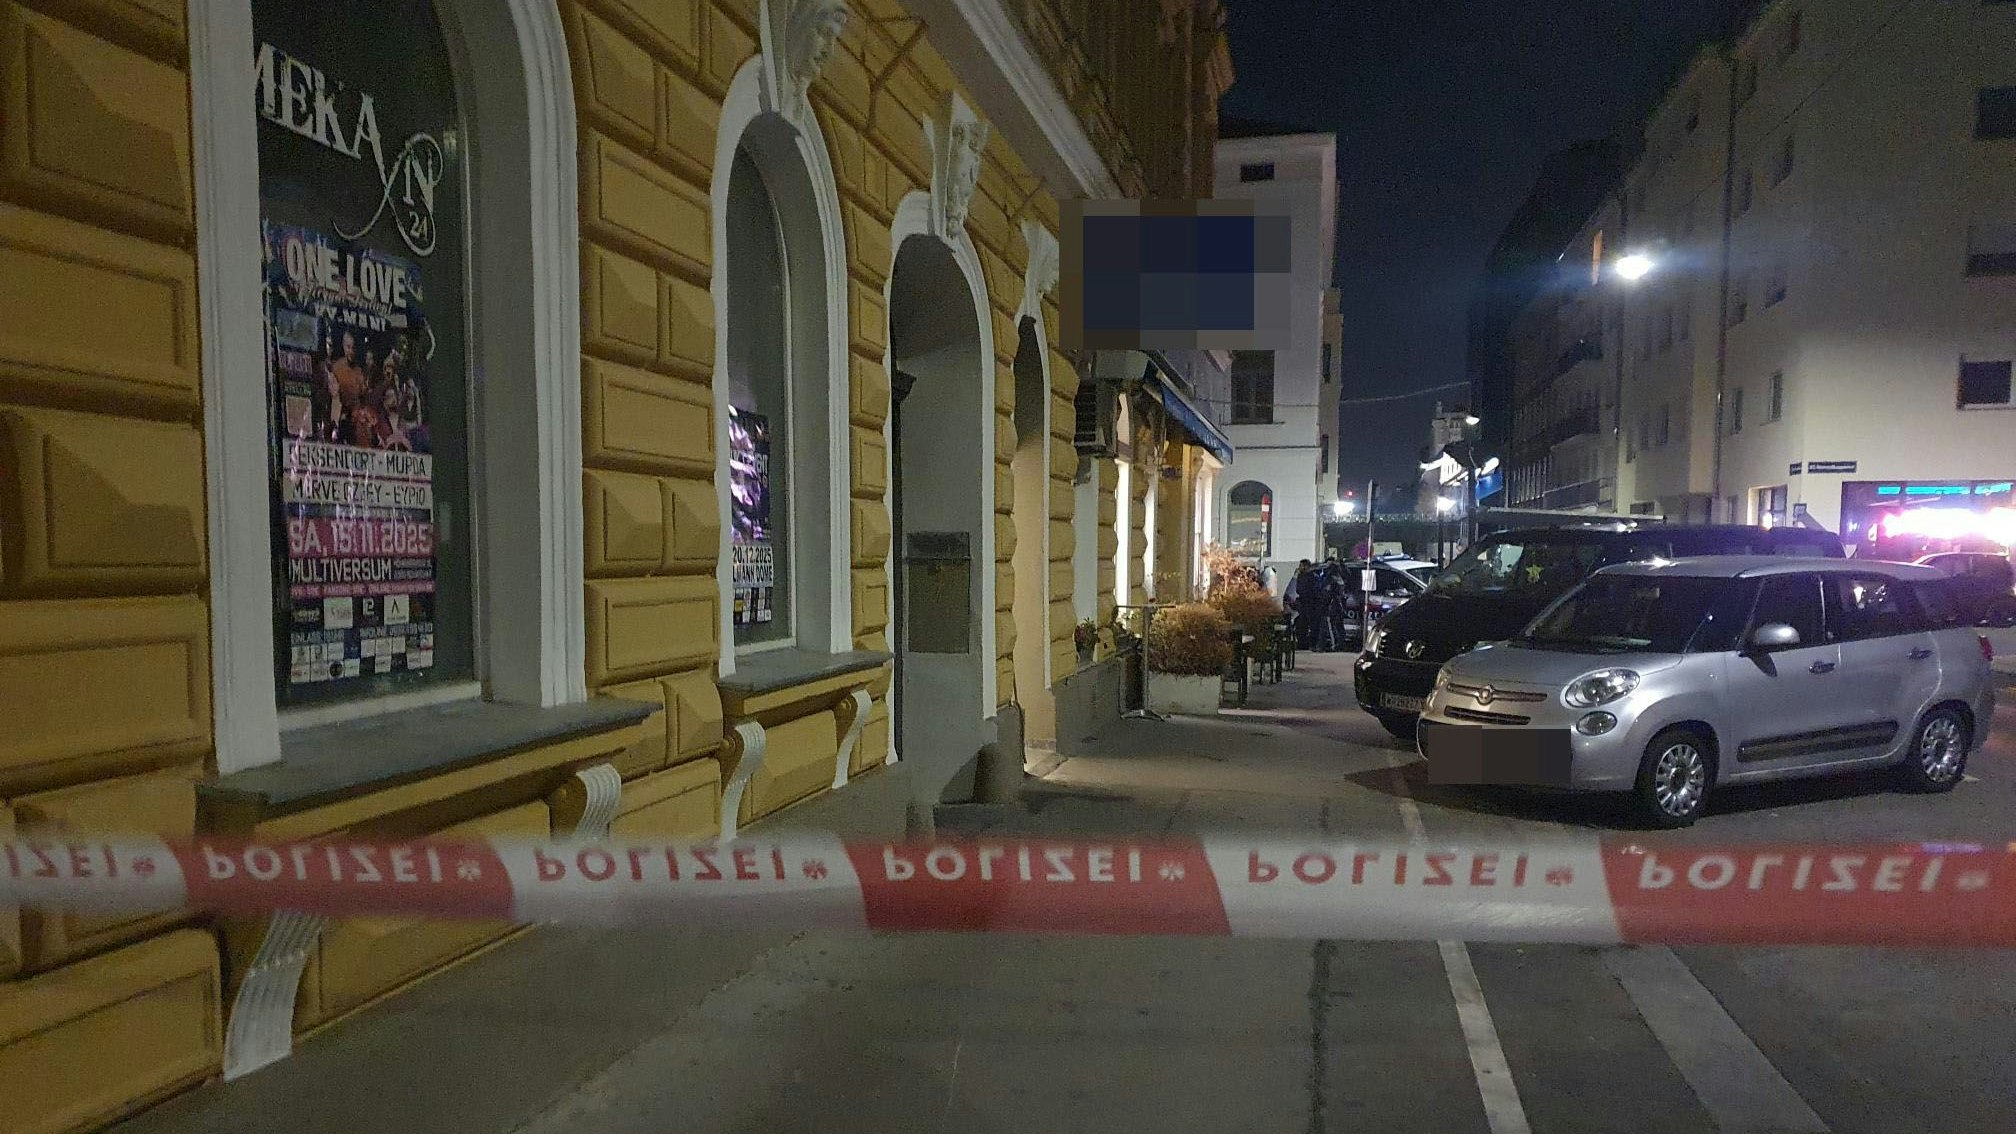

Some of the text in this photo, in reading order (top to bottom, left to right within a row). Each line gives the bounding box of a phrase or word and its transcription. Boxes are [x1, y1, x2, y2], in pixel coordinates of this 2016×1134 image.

[286, 238, 340, 290] ONE
[346, 254, 407, 309] LOVE
[292, 477, 340, 501] MRVE
[732, 546, 772, 564] 20.12.2025
[291, 557, 392, 582] MULTIVERSUM
